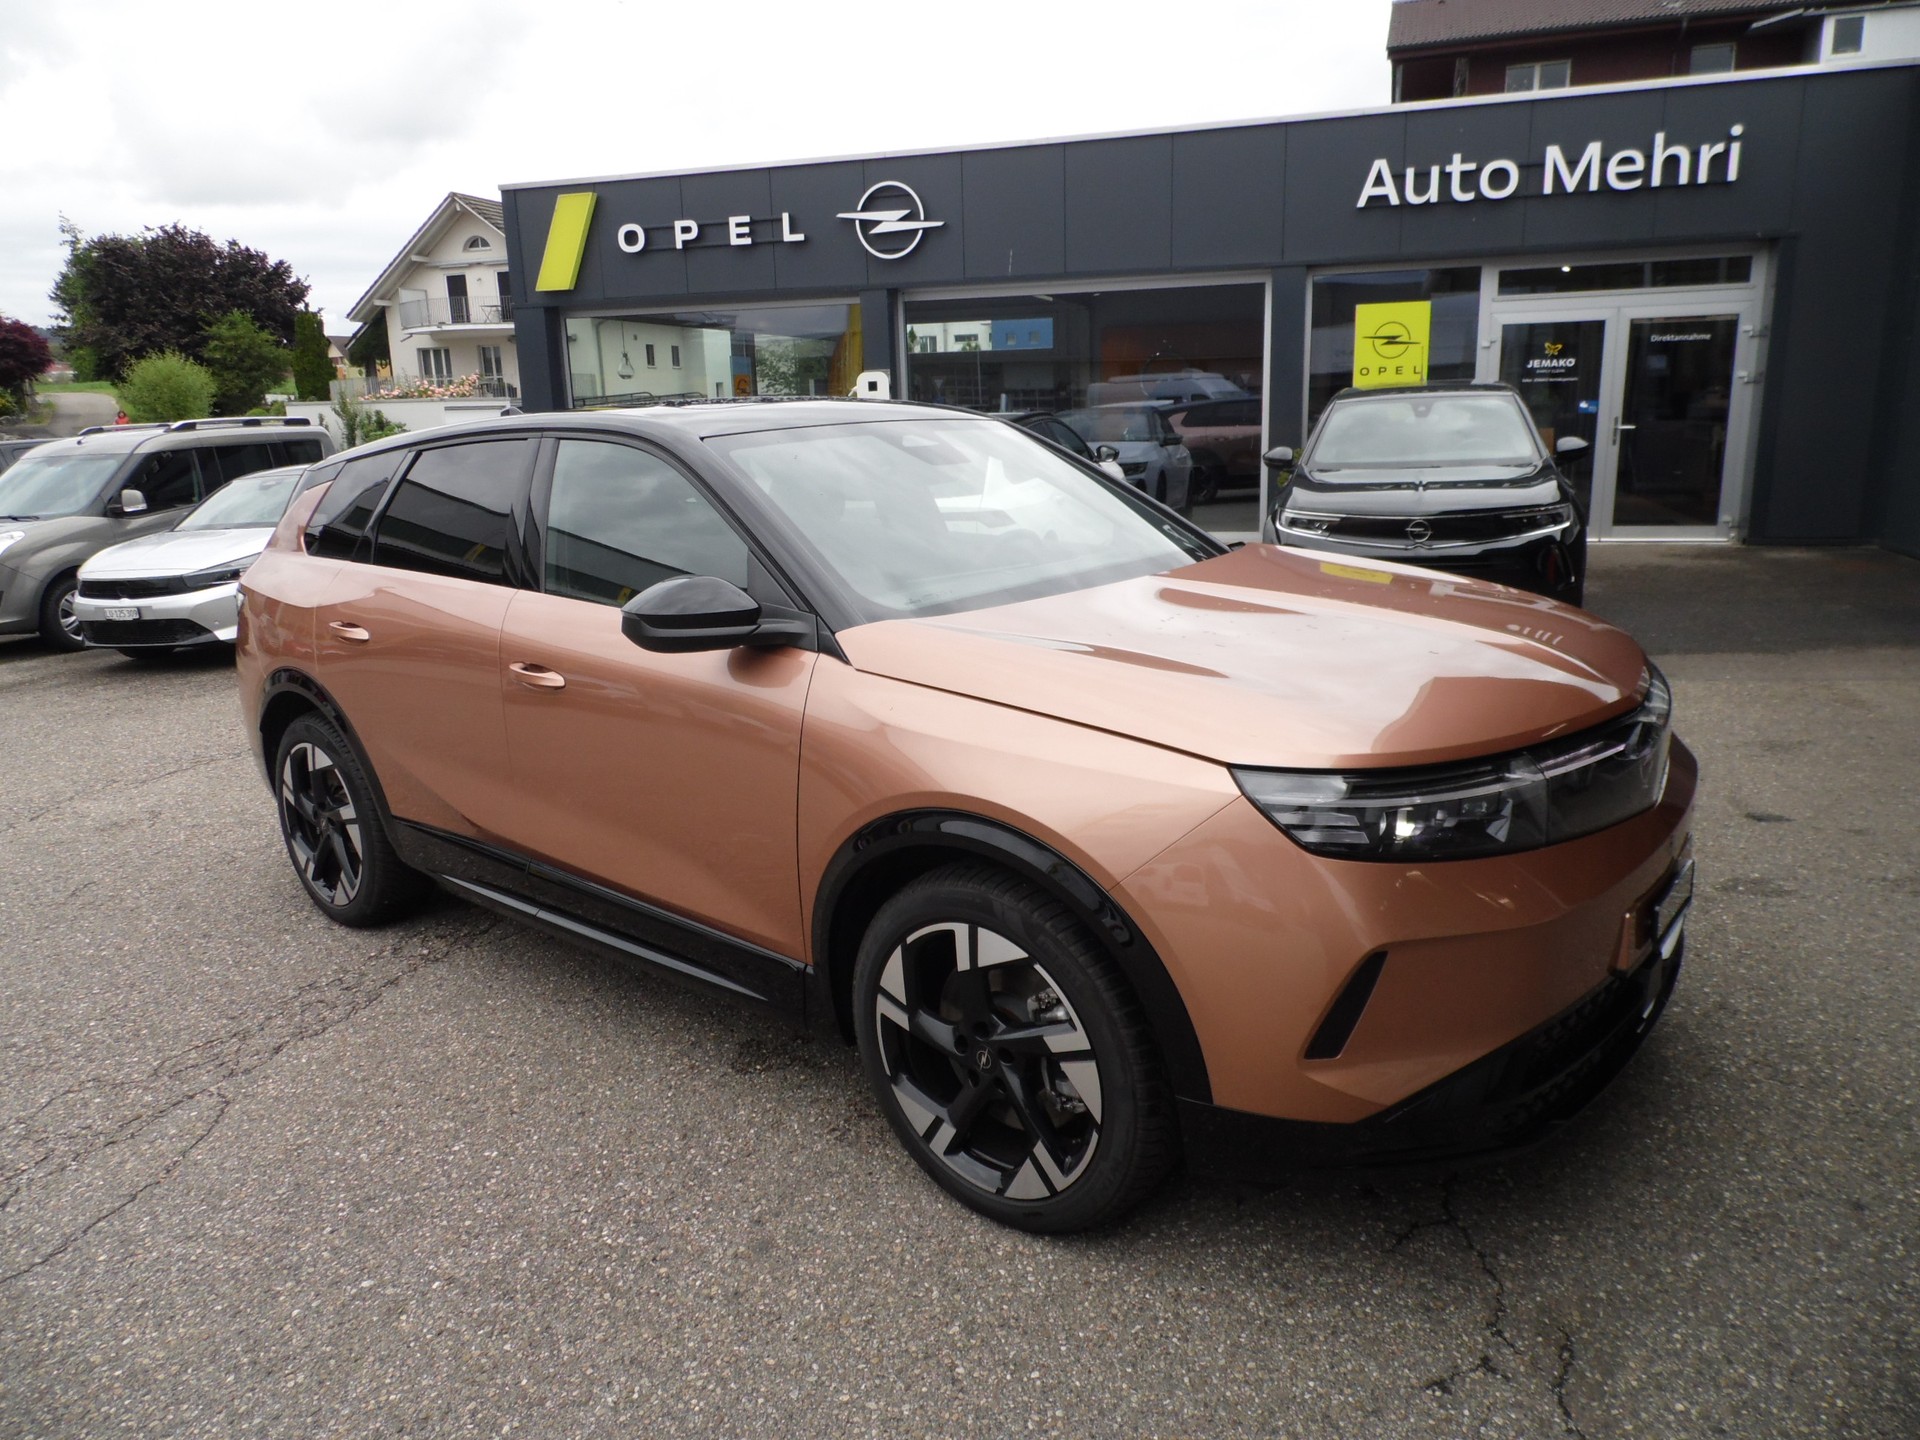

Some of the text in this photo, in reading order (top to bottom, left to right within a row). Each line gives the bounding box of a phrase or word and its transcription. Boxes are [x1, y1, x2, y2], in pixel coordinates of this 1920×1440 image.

[1356, 123, 1744, 208] Auto Mehri
[617, 211, 805, 254] OPEL
[1650, 333, 1712, 342] Direktannahme
[1526, 358, 1576, 369] JEMAKO
[1359, 365, 1422, 377] OPEL
